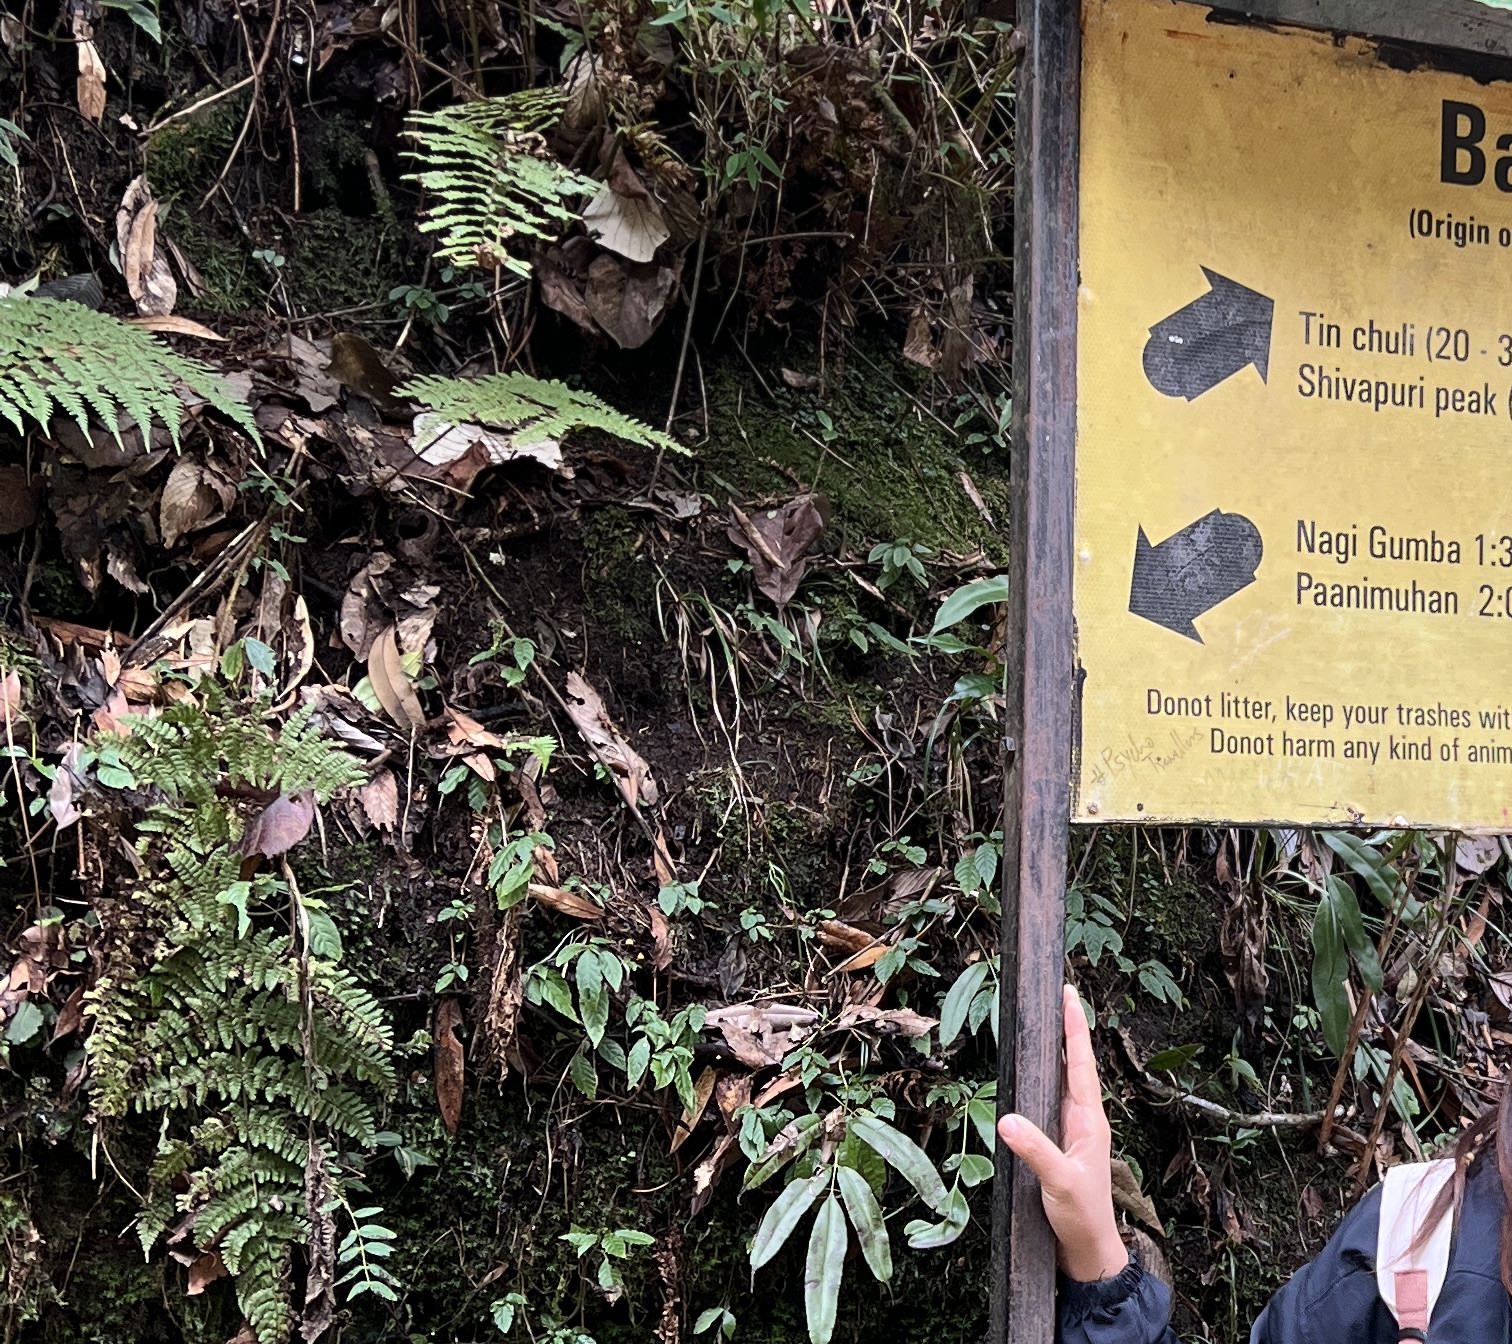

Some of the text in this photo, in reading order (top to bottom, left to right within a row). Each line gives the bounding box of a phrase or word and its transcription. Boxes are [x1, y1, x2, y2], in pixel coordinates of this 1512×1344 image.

[1410, 208, 1489, 247] (Origin
[1299, 312, 1340, 348] Tin
[1353, 320, 1414, 356] chuli
[1427, 327, 1469, 362] (20
[1298, 364, 1424, 411] Shivapuri
[1436, 383, 1496, 417] peak
[1298, 520, 1356, 564] Nagi
[1370, 526, 1460, 563] Gumba
[1297, 572, 1457, 614] Paanimuhan
[1148, 689, 1212, 717] Donot
[1221, 692, 1276, 723] litter,
[1287, 696, 1333, 728] keep
[1343, 706, 1388, 729] your
[1397, 703, 1470, 728] trashes
[1211, 728, 1273, 755] Donot
[1283, 731, 1334, 757] harm
[1344, 741, 1380, 765] any
[1390, 735, 1431, 760] kind
[1441, 738, 1459, 761] of
